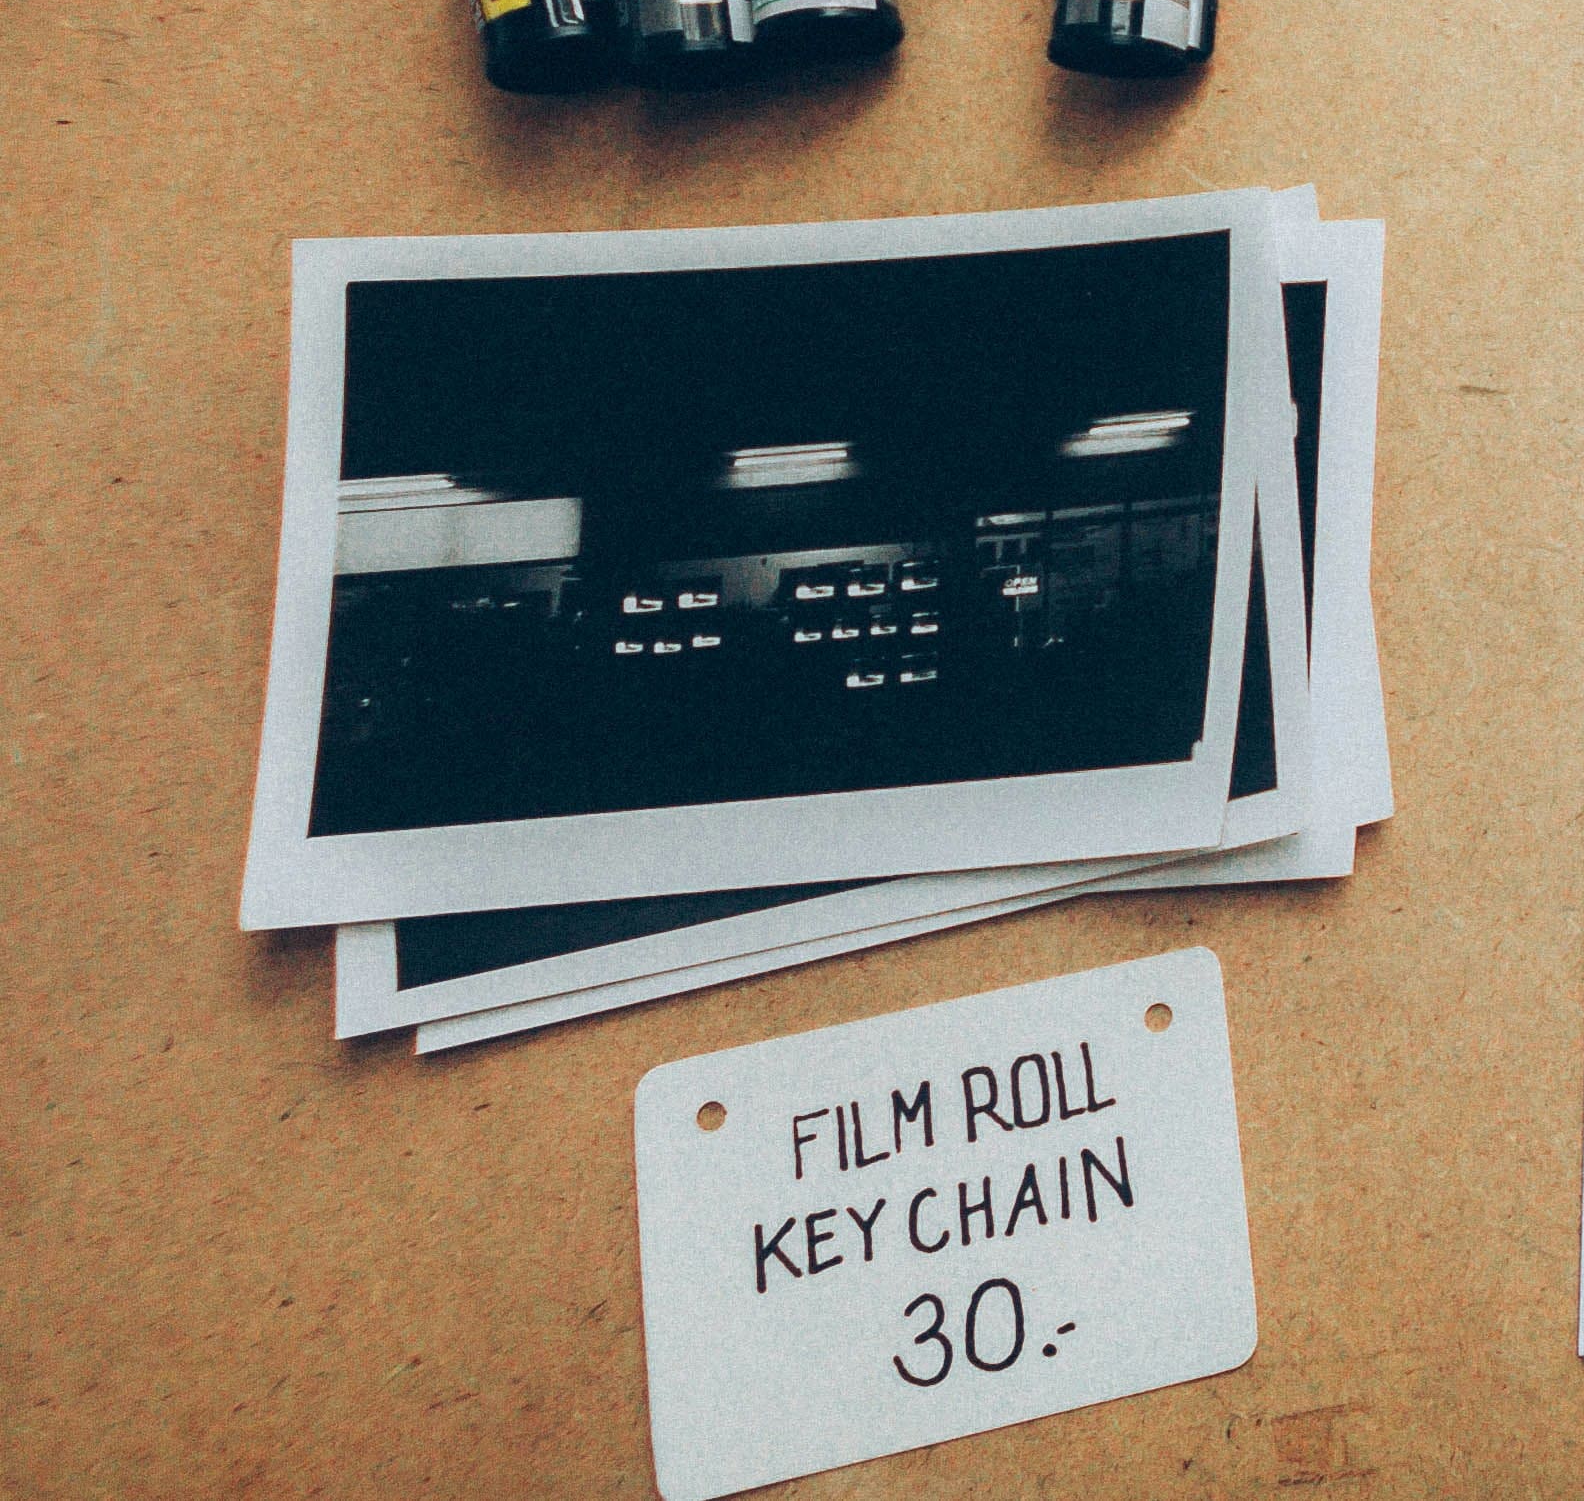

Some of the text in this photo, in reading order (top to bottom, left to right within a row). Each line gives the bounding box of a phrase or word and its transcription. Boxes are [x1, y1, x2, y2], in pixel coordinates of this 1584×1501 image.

[793, 1041, 1117, 1180] FILM ROLL
[892, 1277, 1077, 1387] 30.-
